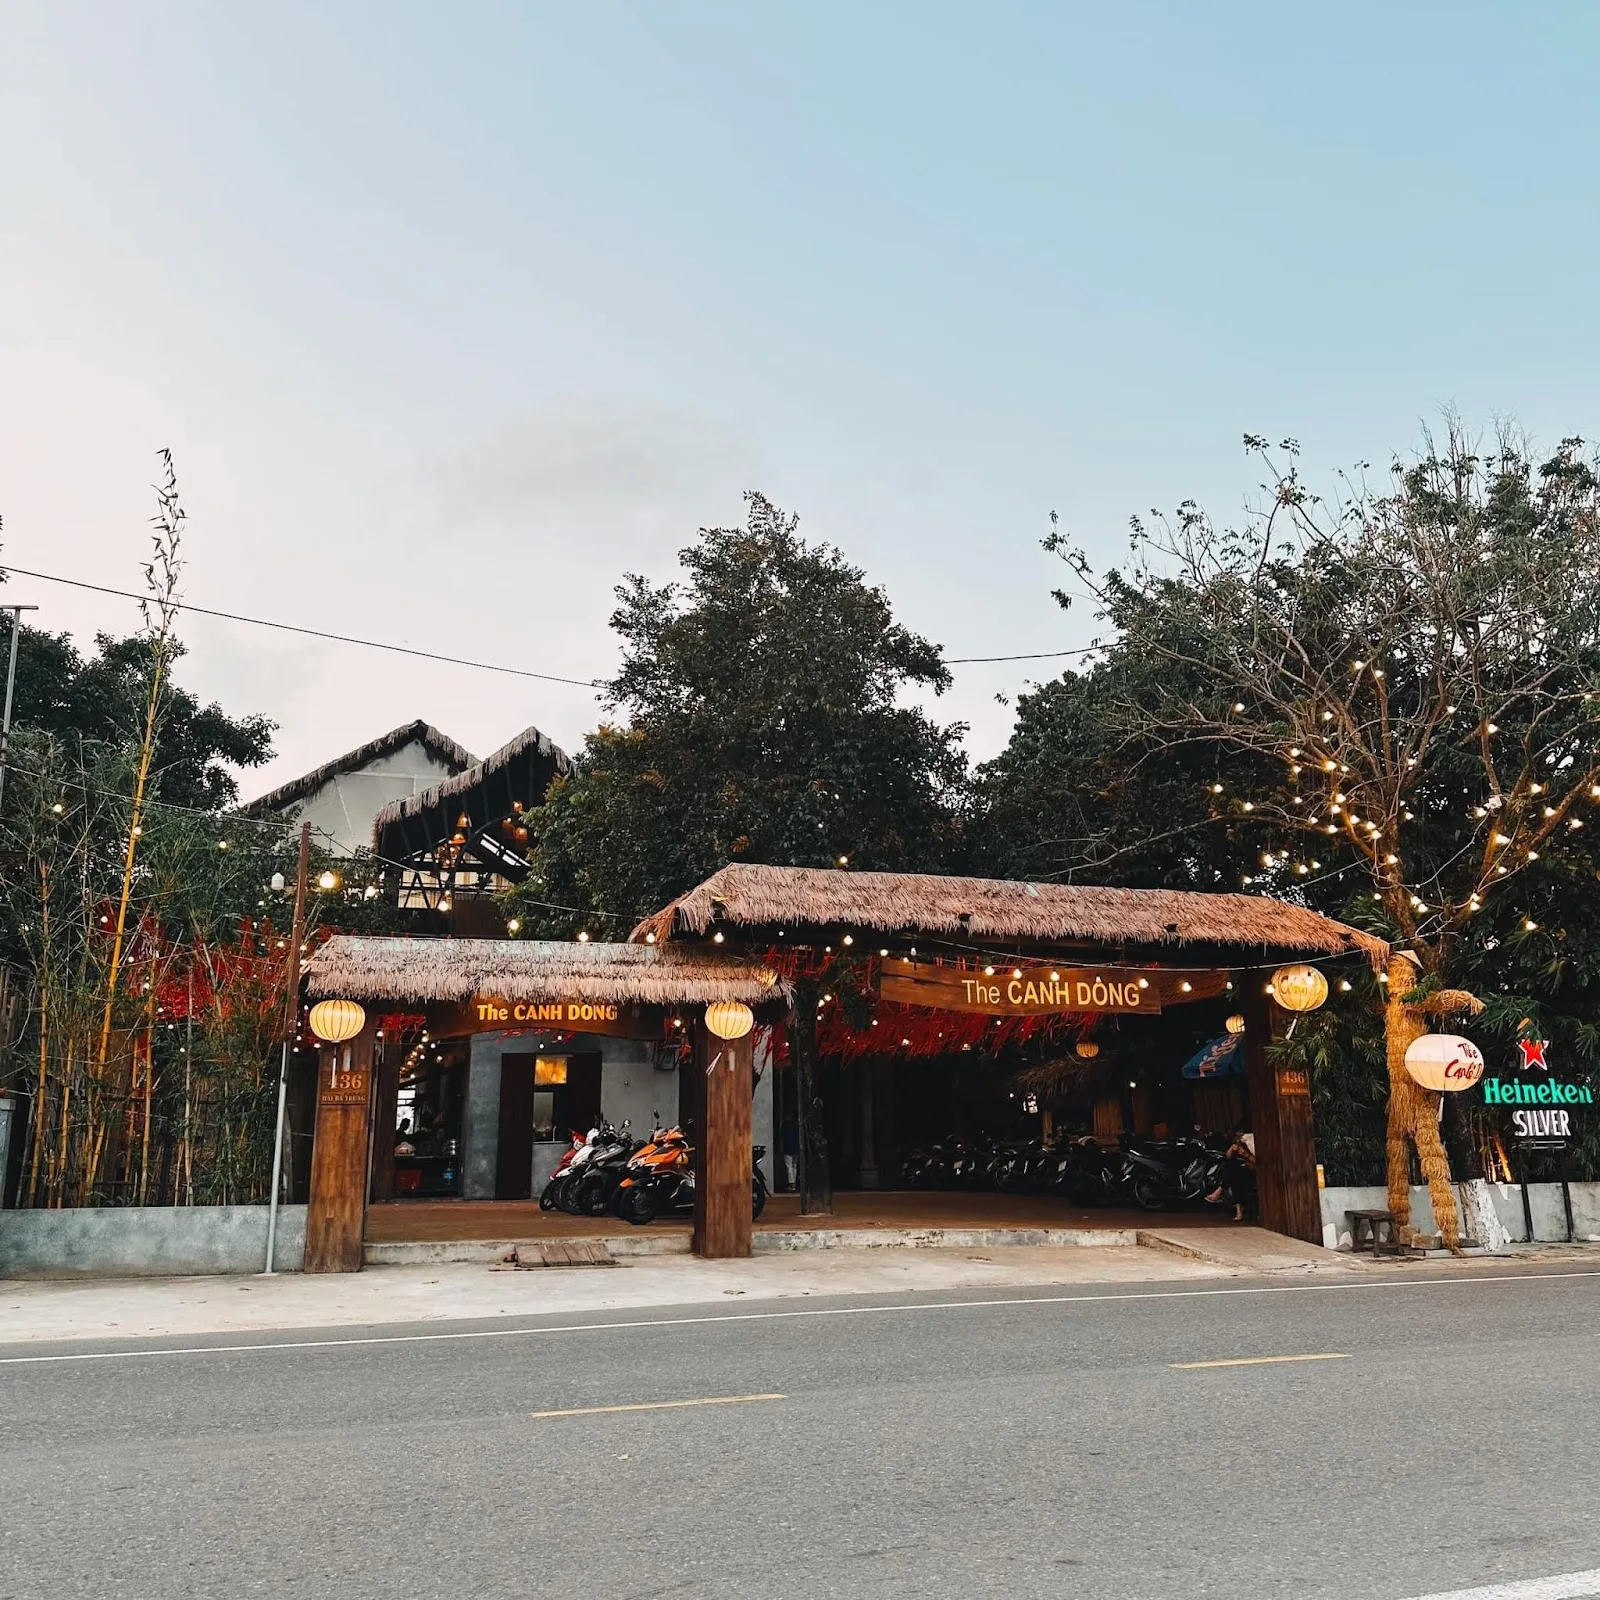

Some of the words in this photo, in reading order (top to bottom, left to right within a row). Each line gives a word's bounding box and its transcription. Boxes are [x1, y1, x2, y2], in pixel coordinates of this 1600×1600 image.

[961, 979, 1000, 1004] The
[1007, 980, 1070, 1005] CANH
[476, 1003, 508, 1021] The
[513, 1004, 562, 1021] CANH
[567, 1004, 618, 1021] DONG
[1457, 1043, 1478, 1059] The
[1283, 1071, 1305, 1084] 436
[1484, 1077, 1594, 1104] Heineken
[1512, 1109, 1571, 1137] SILVER
